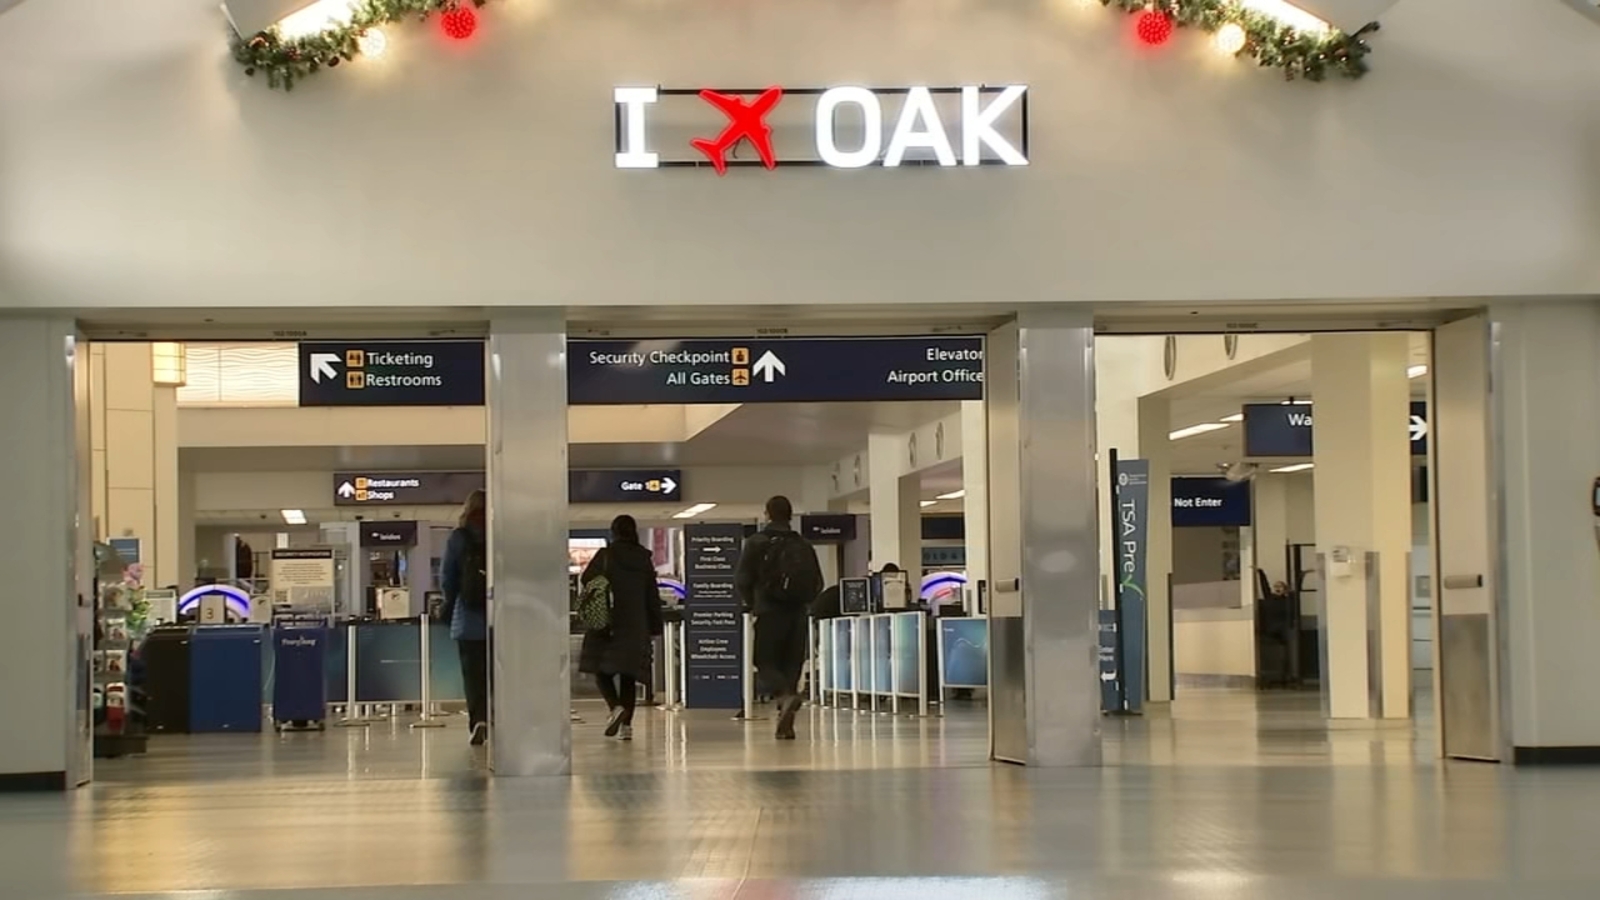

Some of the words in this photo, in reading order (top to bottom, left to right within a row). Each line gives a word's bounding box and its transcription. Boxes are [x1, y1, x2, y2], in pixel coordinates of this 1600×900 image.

[614, 87, 658, 168] I
[815, 86, 1029, 168] OAK
[366, 352, 434, 368] Ticketing
[589, 351, 646, 366] Security
[650, 350, 730, 365] Checkpoint
[366, 373, 442, 386] Restrooms
[666, 372, 686, 385] All
[690, 372, 731, 385] Gates
[887, 370, 938, 385] Airport
[367, 479, 420, 488] Restaurants
[620, 481, 643, 491] Gate
[367, 490, 395, 500] Shops
[1174, 498, 1193, 507] Not
[1195, 498, 1222, 507] Enter
[1122, 499, 1136, 536] TSA
[1123, 541, 1137, 573] Pre
